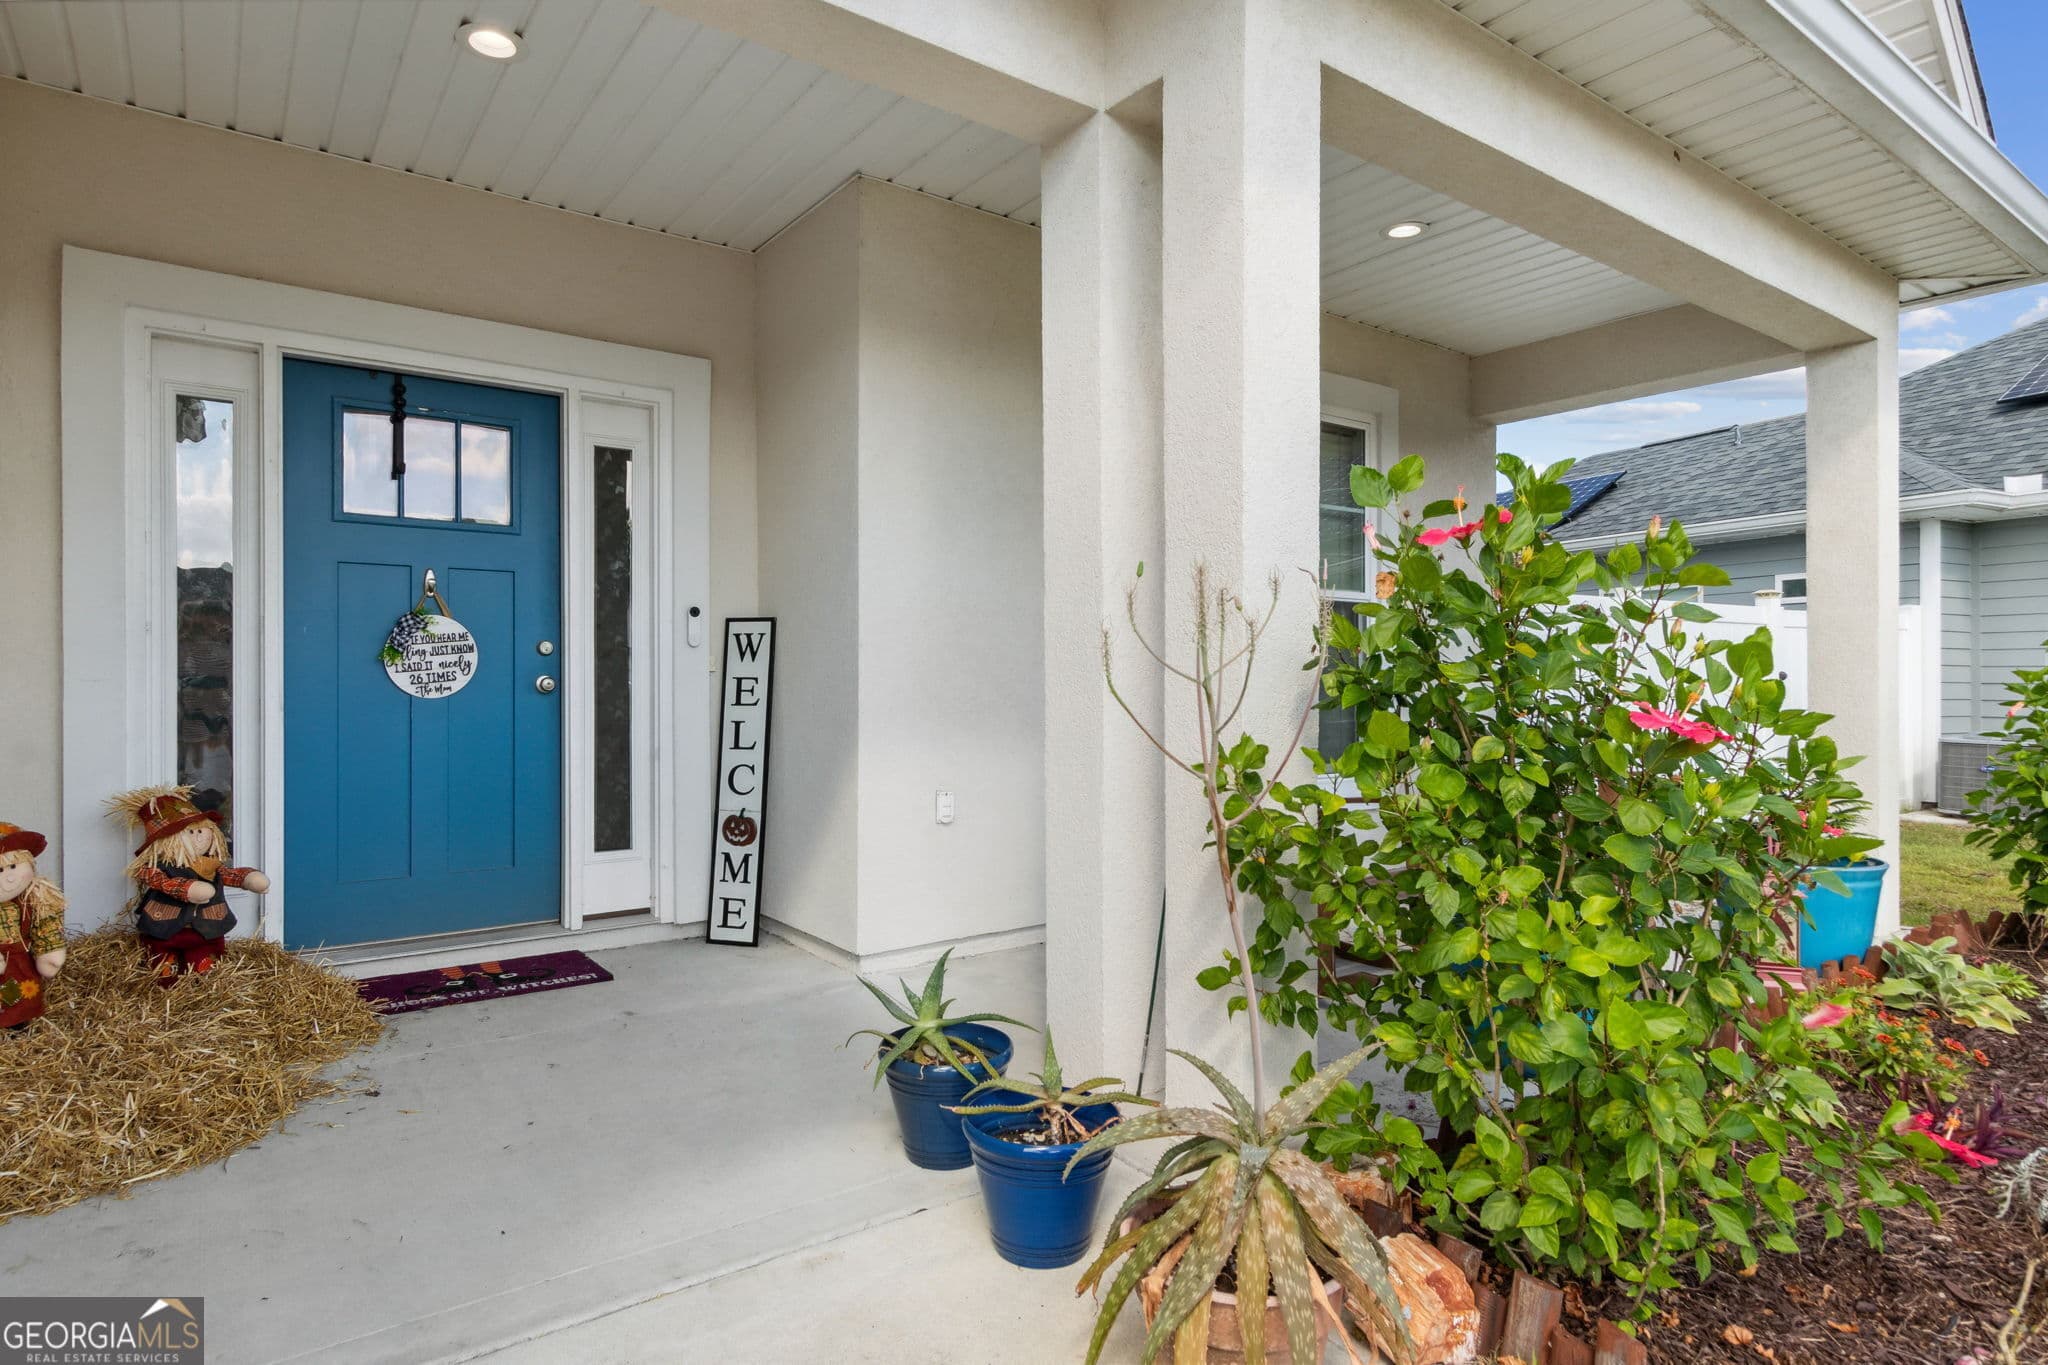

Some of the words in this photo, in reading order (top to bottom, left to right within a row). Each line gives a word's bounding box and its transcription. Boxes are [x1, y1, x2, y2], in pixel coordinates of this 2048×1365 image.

[411, 635, 418, 644] IF
[420, 633, 436, 643] YOU
[437, 632, 456, 642] HEAR
[457, 632, 469, 641] ME
[429, 645, 449, 656] JUST
[451, 643, 474, 654] KNOW
[401, 662, 422, 672] SAID
[425, 661, 433, 671] IT
[439, 655, 472, 676] nicely
[409, 674, 423, 685] 26
[426, 671, 457, 683] TIMES
